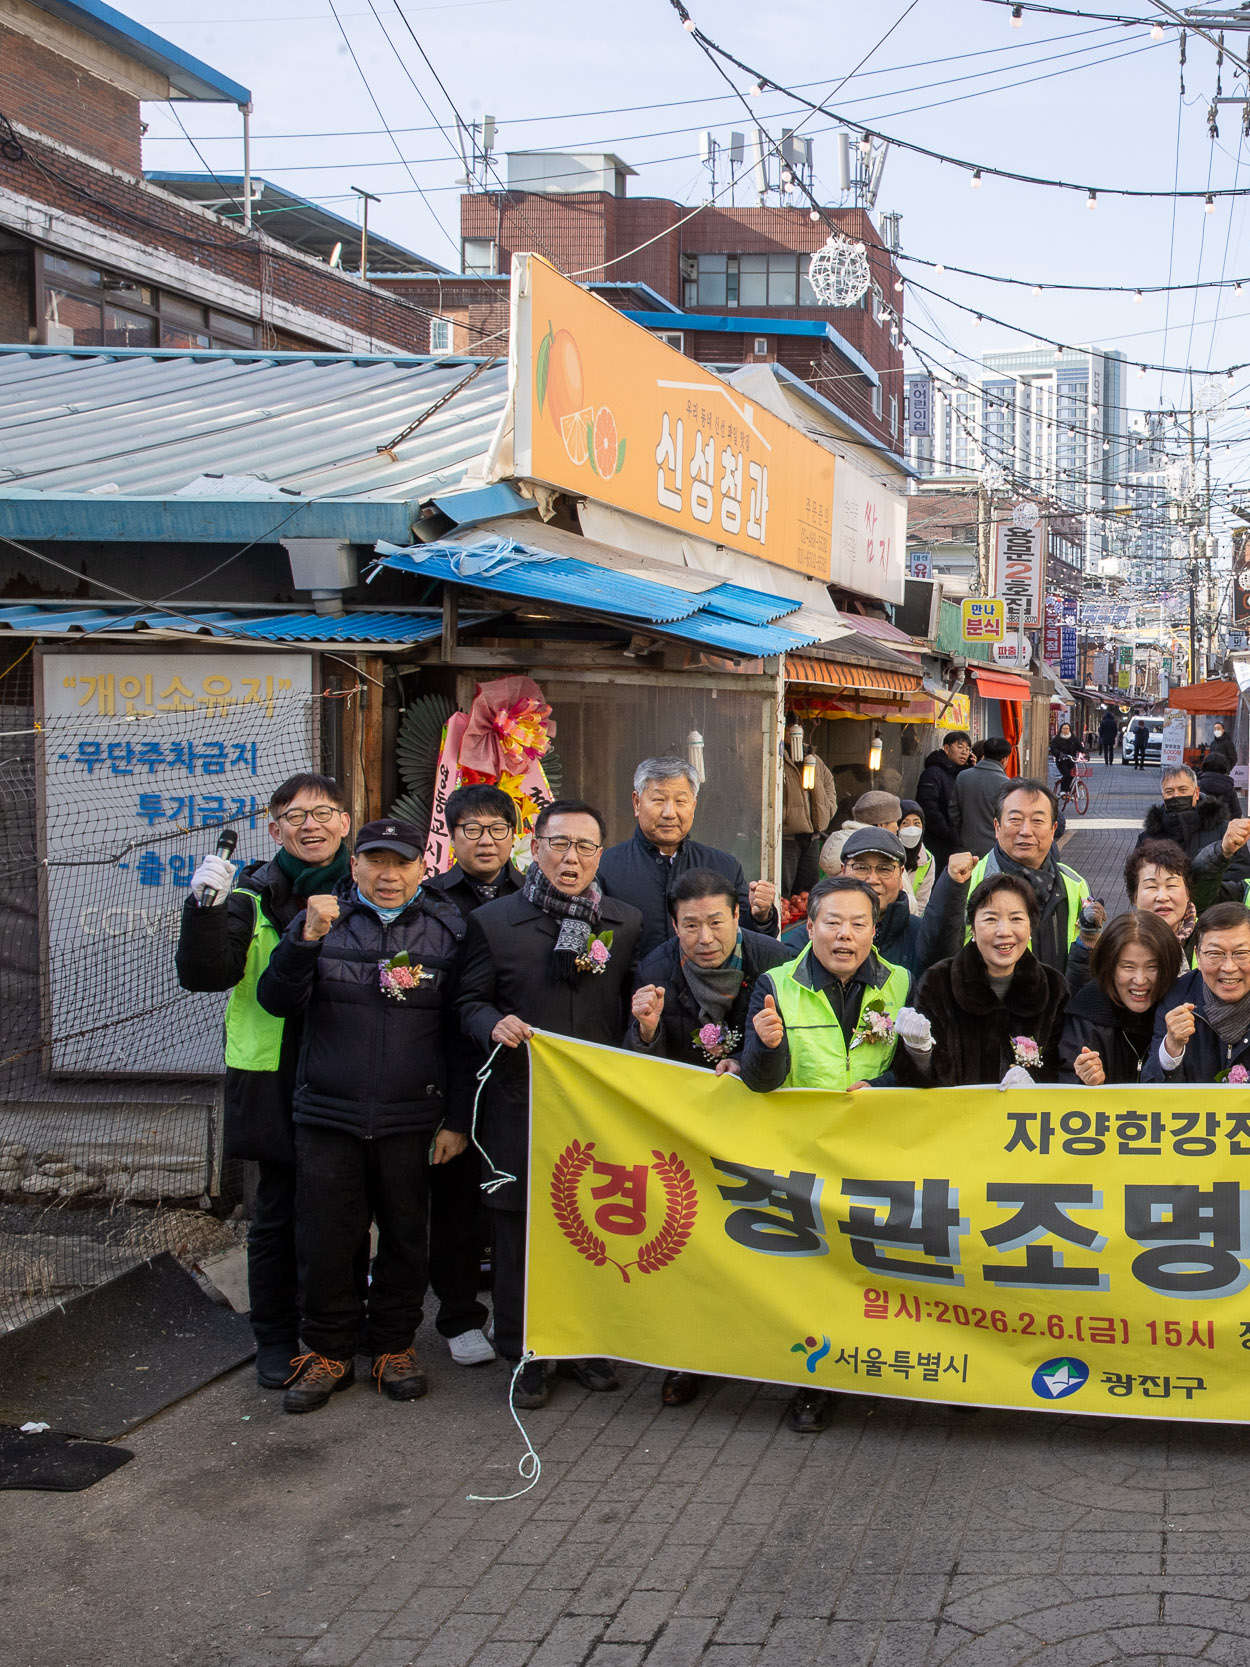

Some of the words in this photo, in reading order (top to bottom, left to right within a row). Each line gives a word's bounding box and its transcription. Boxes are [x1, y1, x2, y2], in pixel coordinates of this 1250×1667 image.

[913, 389, 927, 431] 어린이집
[655, 411, 769, 545] 신성청과
[965, 617, 1000, 637] 분식
[971, 604, 995, 616] 만나
[135, 792, 257, 830] 투기금지
[590, 1160, 650, 1237] 경
[709, 1157, 1250, 1300] 경관조명
[862, 1288, 1130, 1346] 일시:2026.2.6.(금)
[1145, 1318, 1217, 1351] 15시
[834, 1343, 970, 1385] 서울특별시
[1100, 1372, 1209, 1400] 광진구
